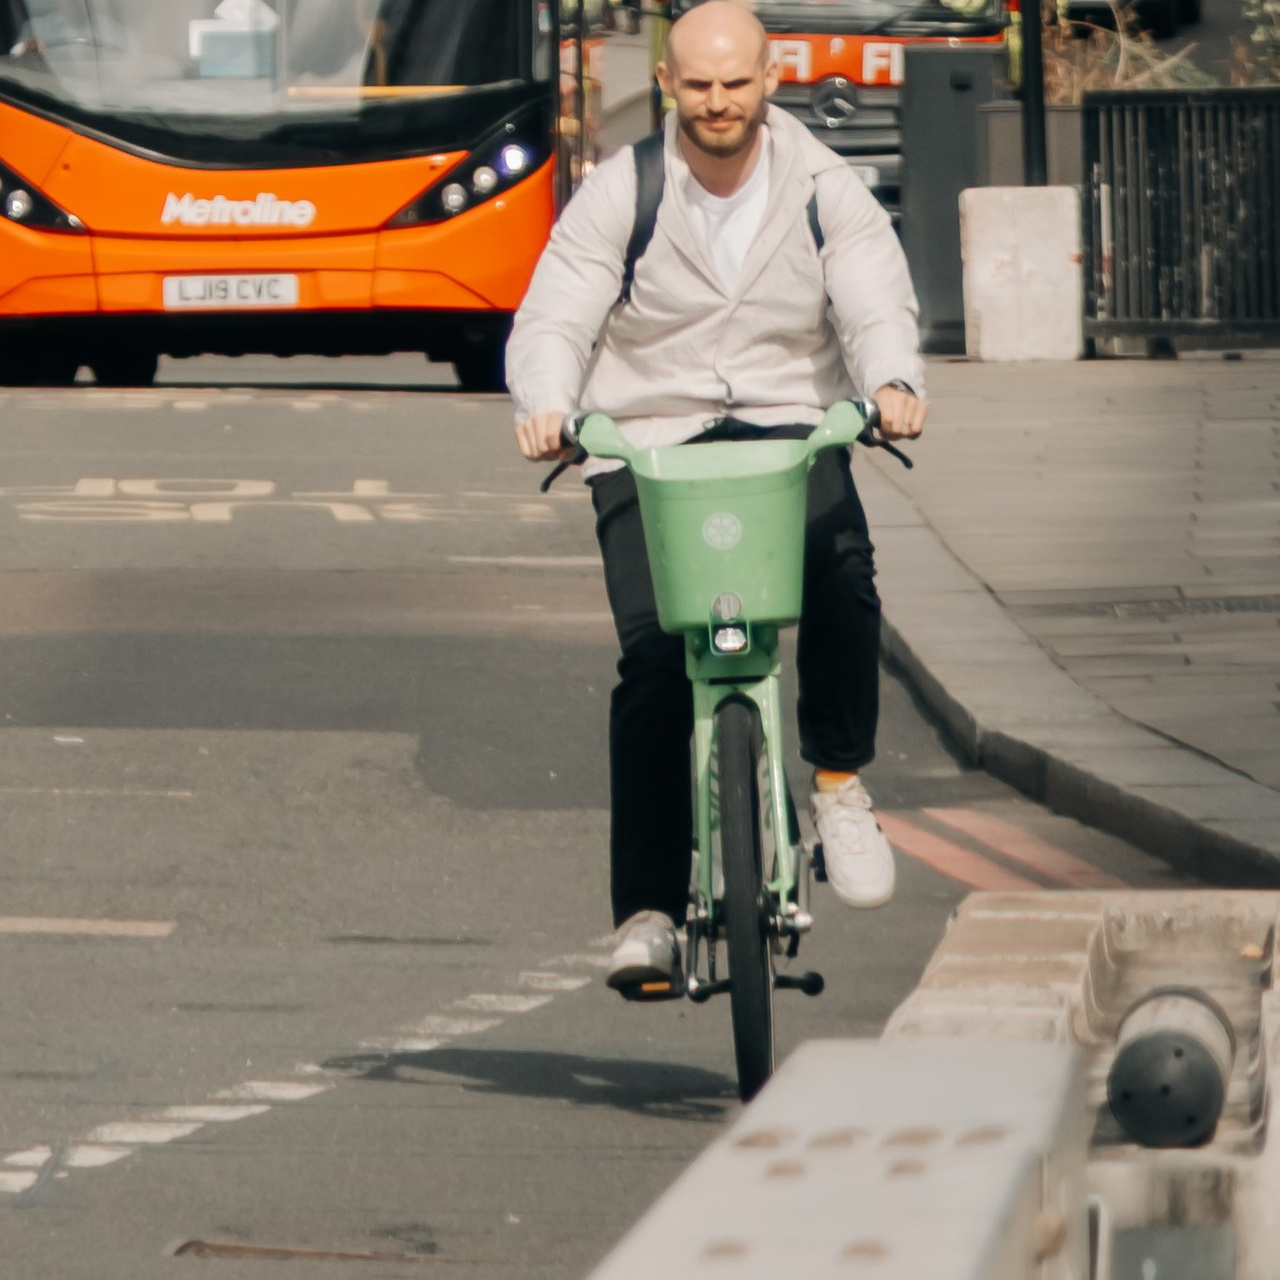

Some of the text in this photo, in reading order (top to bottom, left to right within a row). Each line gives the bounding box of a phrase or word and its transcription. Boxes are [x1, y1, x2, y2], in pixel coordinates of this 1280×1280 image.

[160, 191, 317, 227] Metroline
[178, 278, 281, 301] LJ19 CVC
